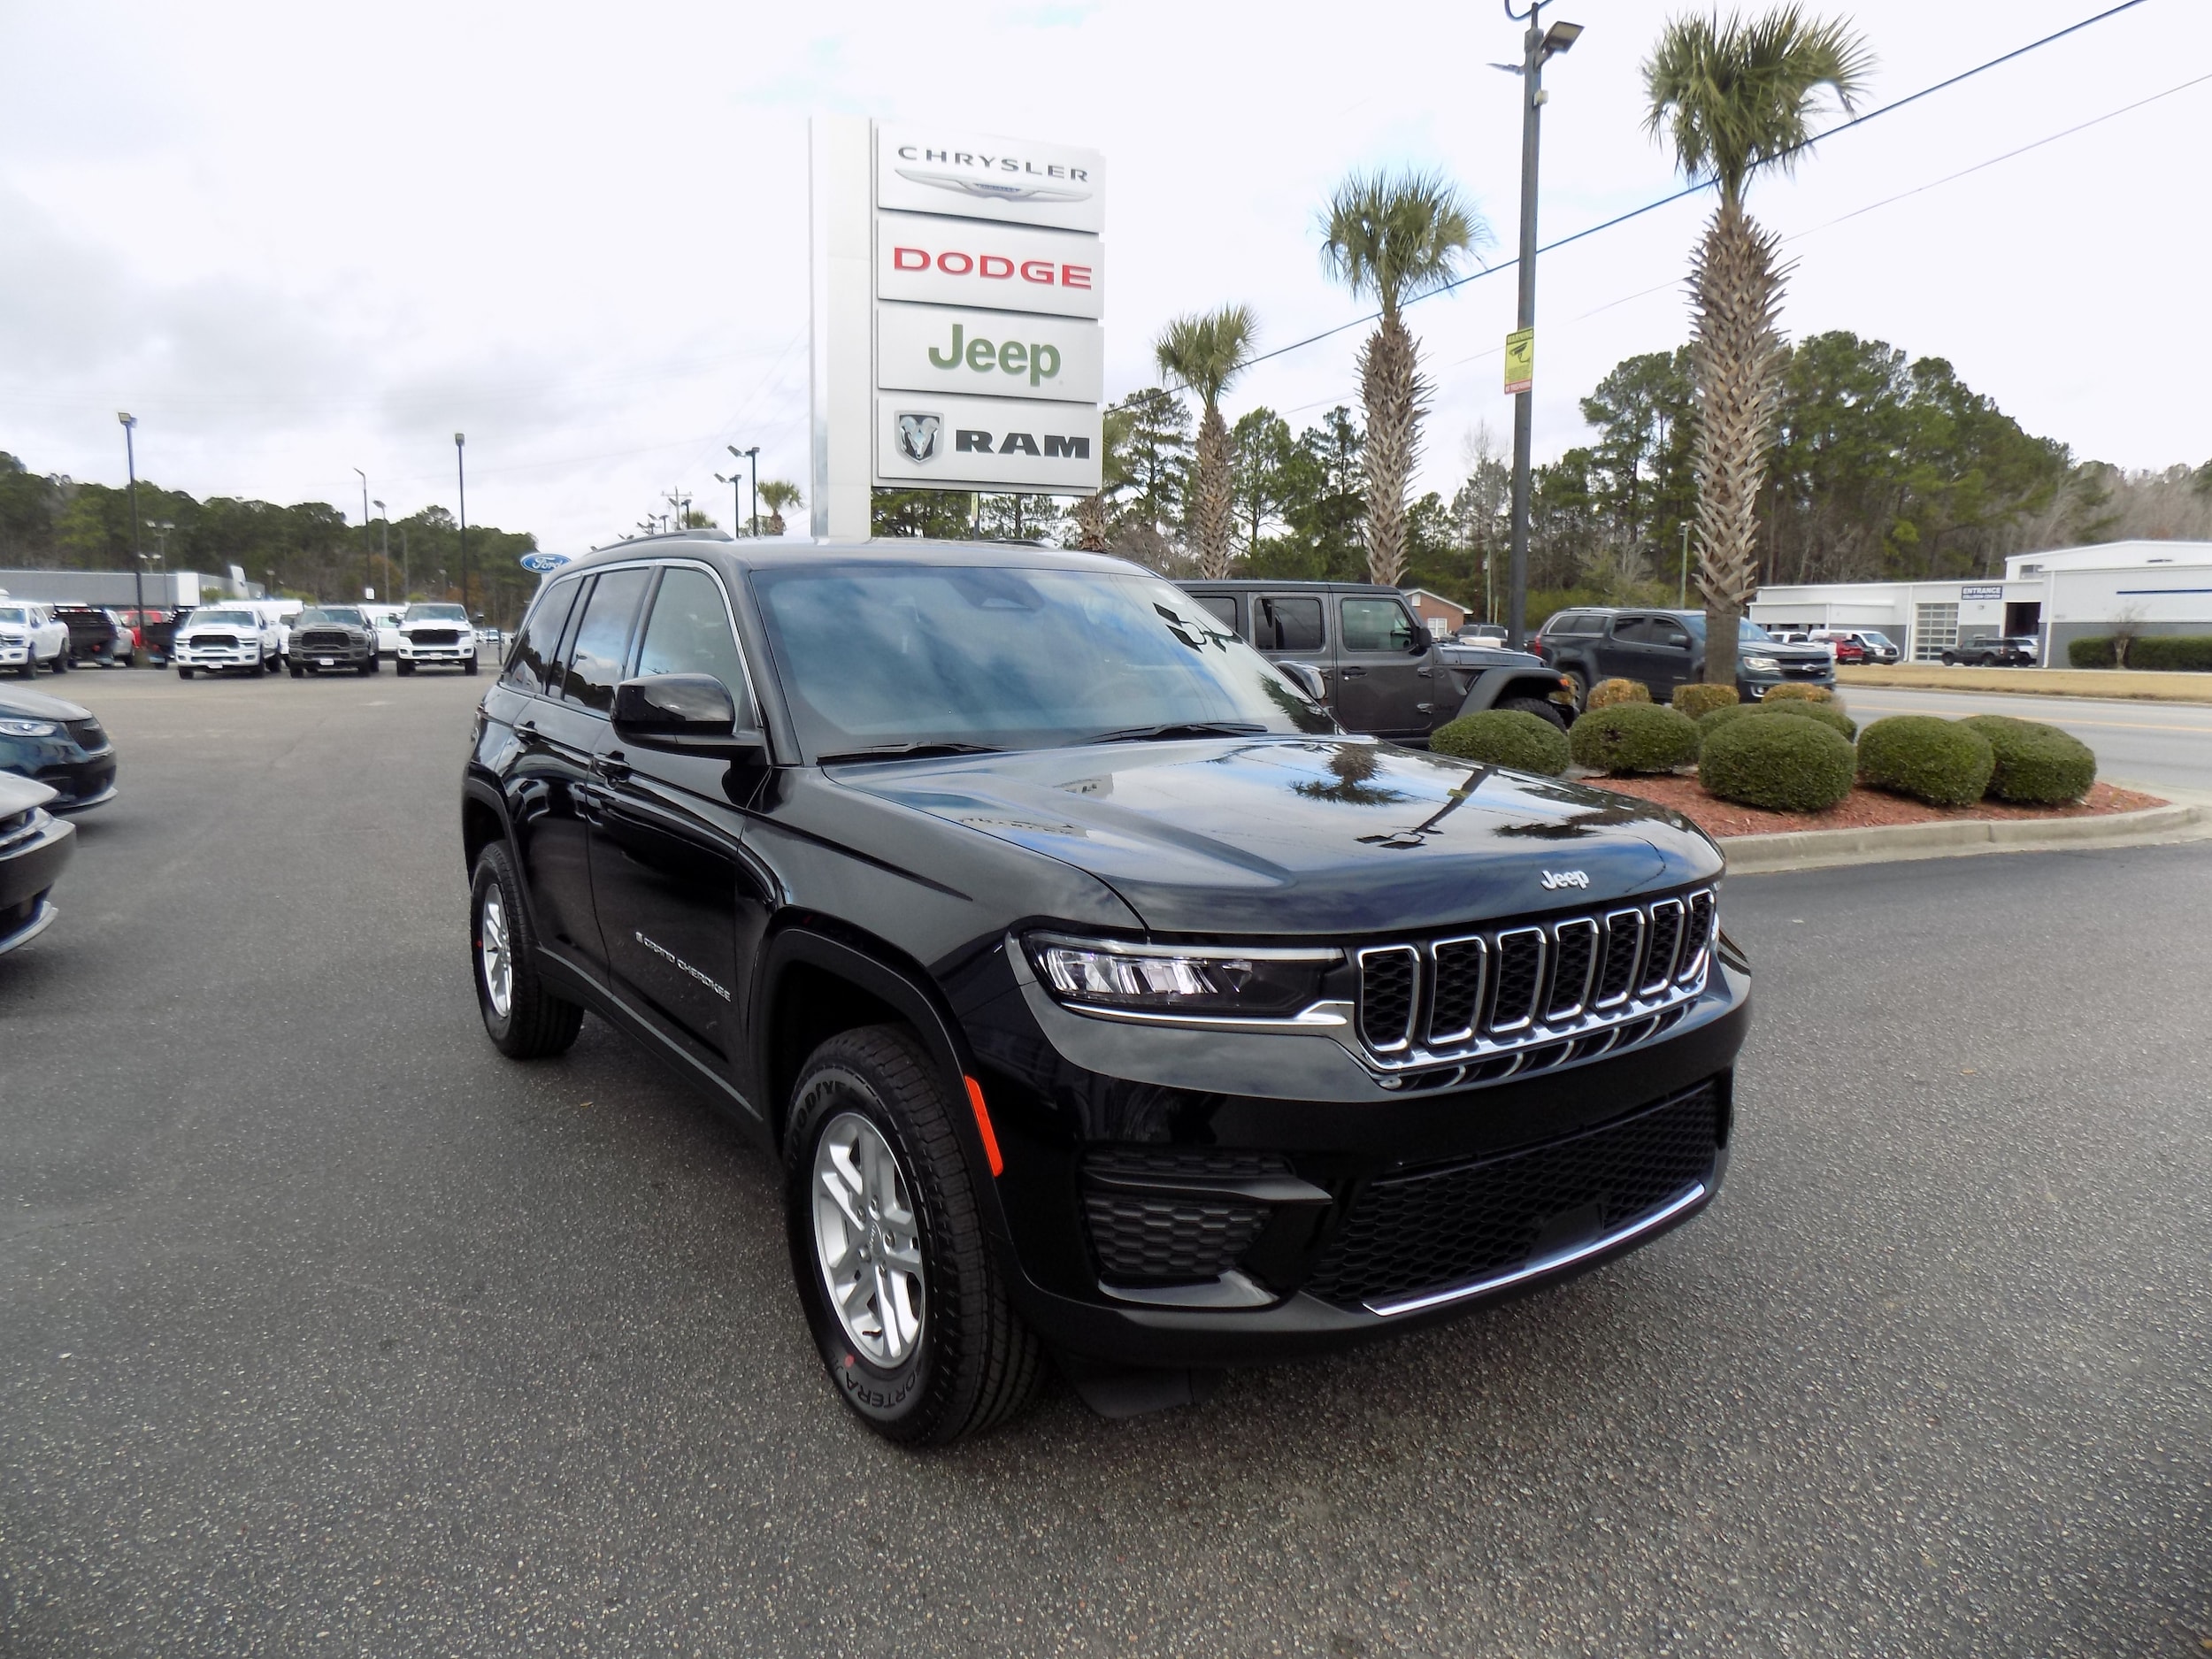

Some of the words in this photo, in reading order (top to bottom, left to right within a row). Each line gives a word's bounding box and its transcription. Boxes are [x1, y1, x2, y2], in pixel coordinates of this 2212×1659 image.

[897, 146, 1088, 183] CHRYSLER
[894, 247, 1093, 291] DODGE
[928, 324, 1062, 387] Jeep
[956, 429, 1090, 459] RAM
[532, 557, 564, 569] Ford
[1540, 870, 1590, 889] Jeep
